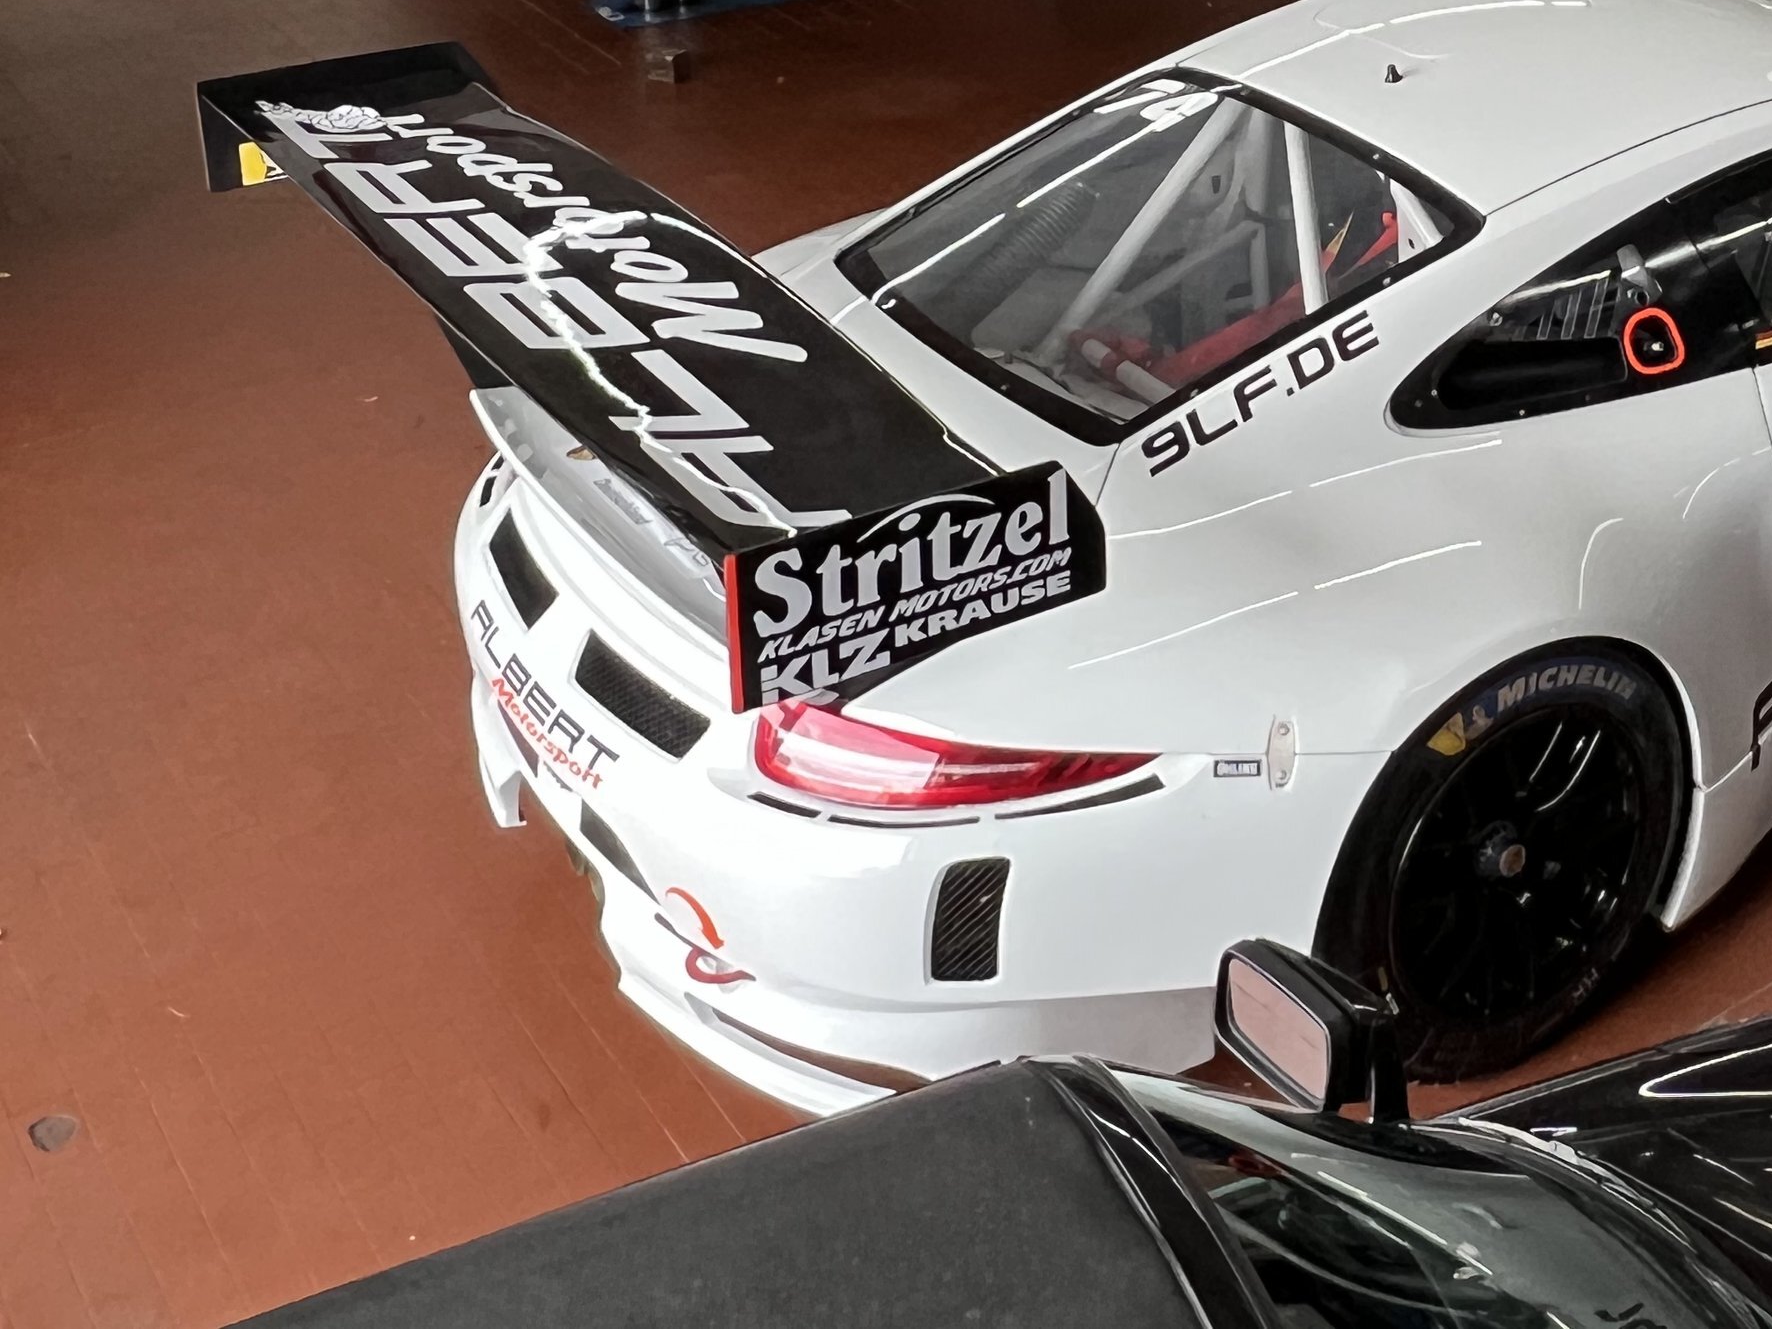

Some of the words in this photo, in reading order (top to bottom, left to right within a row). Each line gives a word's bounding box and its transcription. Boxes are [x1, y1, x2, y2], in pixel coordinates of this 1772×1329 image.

[258, 105, 853, 531] ALBERT
[1141, 310, 1380, 478] 9LF.DE
[753, 468, 1070, 638] Stritzel
[471, 599, 620, 771] ALBERT
[757, 605, 886, 664] KLASEN
[760, 628, 891, 707] KLZ
[895, 570, 1072, 647] KRAUSE
[1497, 664, 1638, 713] MICHELIN
[492, 677, 603, 789] Motorsport
